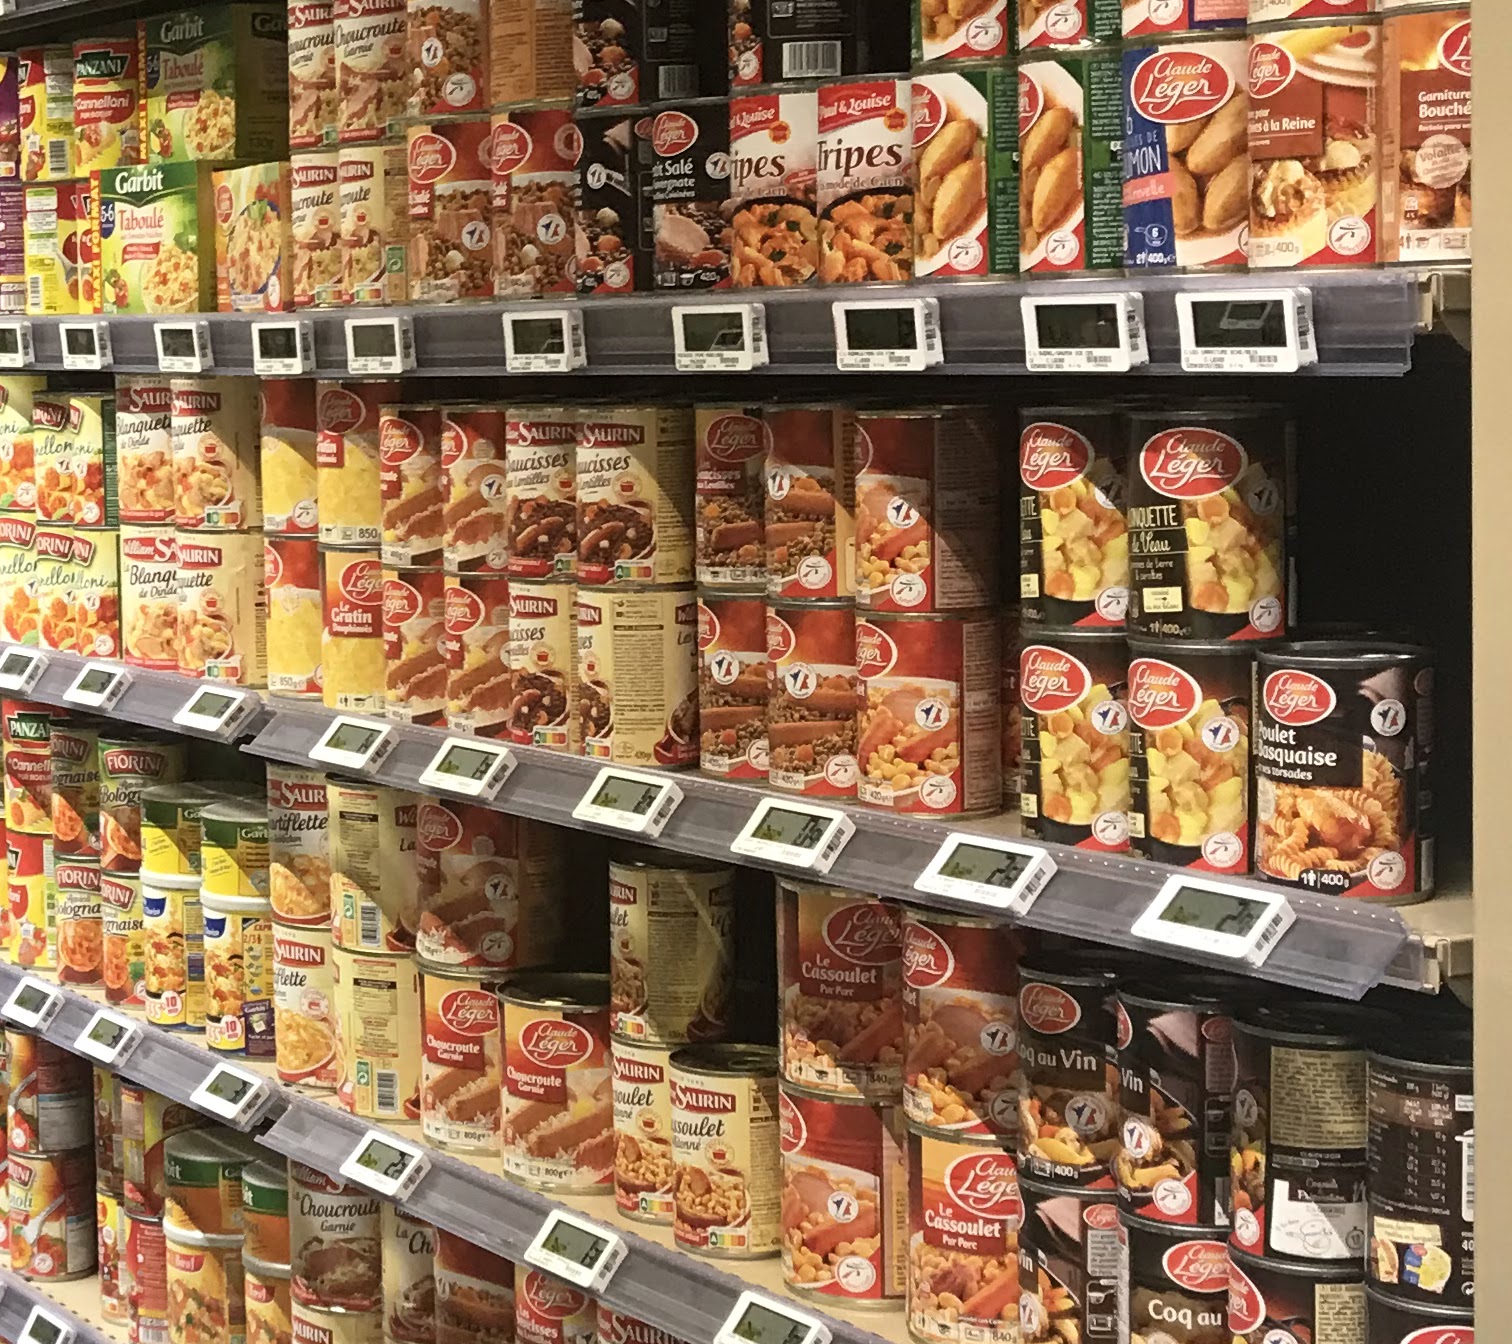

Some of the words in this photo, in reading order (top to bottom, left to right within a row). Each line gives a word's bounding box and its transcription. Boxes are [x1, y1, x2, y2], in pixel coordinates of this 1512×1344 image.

[160, 19, 205, 43] Garbit
[162, 55, 204, 78] Taboulé
[1152, 56, 1212, 78] Claude
[847, 93, 892, 117] Louise
[1139, 73, 1222, 115] Léger
[1270, 118, 1280, 131] la
[1281, 116, 1316, 131] Reine
[664, 159, 694, 176] Salé
[115, 172, 164, 194] Garbit
[90, 178, 101, 255] FORMAT
[117, 208, 164, 232] Taboulé
[92, 265, 101, 310] MAXI
[582, 422, 642, 448] SAURIN
[710, 430, 759, 456] Léger
[1029, 429, 1074, 449] Claude
[1165, 433, 1226, 454] Claude
[1021, 441, 1081, 482] Léger
[1149, 449, 1232, 490] Léger
[1141, 533, 1172, 554] Veau
[330, 607, 373, 625] Gratin
[339, 600, 351, 613] Le
[1028, 650, 1071, 673] Claude
[1135, 663, 1180, 688] Claude
[1277, 674, 1319, 695] Claude
[1021, 663, 1079, 711] Léger
[1129, 680, 1189, 726] Léger
[1269, 685, 1327, 718] Léger
[9, 719, 47, 738] PANZA
[107, 750, 162, 771] FIORINI
[1320, 872, 1350, 888] 400g
[816, 953, 831, 968] Le
[801, 960, 877, 985] Cassoulet
[456, 992, 496, 1009] Claude
[819, 983, 834, 994] Pur
[834, 985, 856, 997] Porc
[165, 995, 178, 1008] 10
[447, 1001, 498, 1028] Léger
[225, 1020, 238, 1034] 10
[537, 1022, 577, 1039] Claude
[426, 1033, 480, 1055] Choucroute
[438, 1047, 464, 1062] Garnie
[528, 1031, 583, 1061] Léger
[1038, 1052, 1057, 1066] au
[1059, 1049, 1099, 1072] Vin
[506, 1066, 562, 1088] Choucroute
[518, 1080, 545, 1096] Garnie
[1121, 1067, 1144, 1093] Vin
[674, 1085, 733, 1110] SAURIN
[299, 1192, 382, 1219] Choucroute
[939, 1202, 953, 1217] Le
[319, 1219, 357, 1234] Garnie
[925, 1211, 1001, 1238] Cassoulet
[942, 1233, 957, 1247] Pur
[957, 1236, 979, 1251] Porc
[1147, 1298, 1193, 1329] Coq
[1197, 1312, 1222, 1326] au
